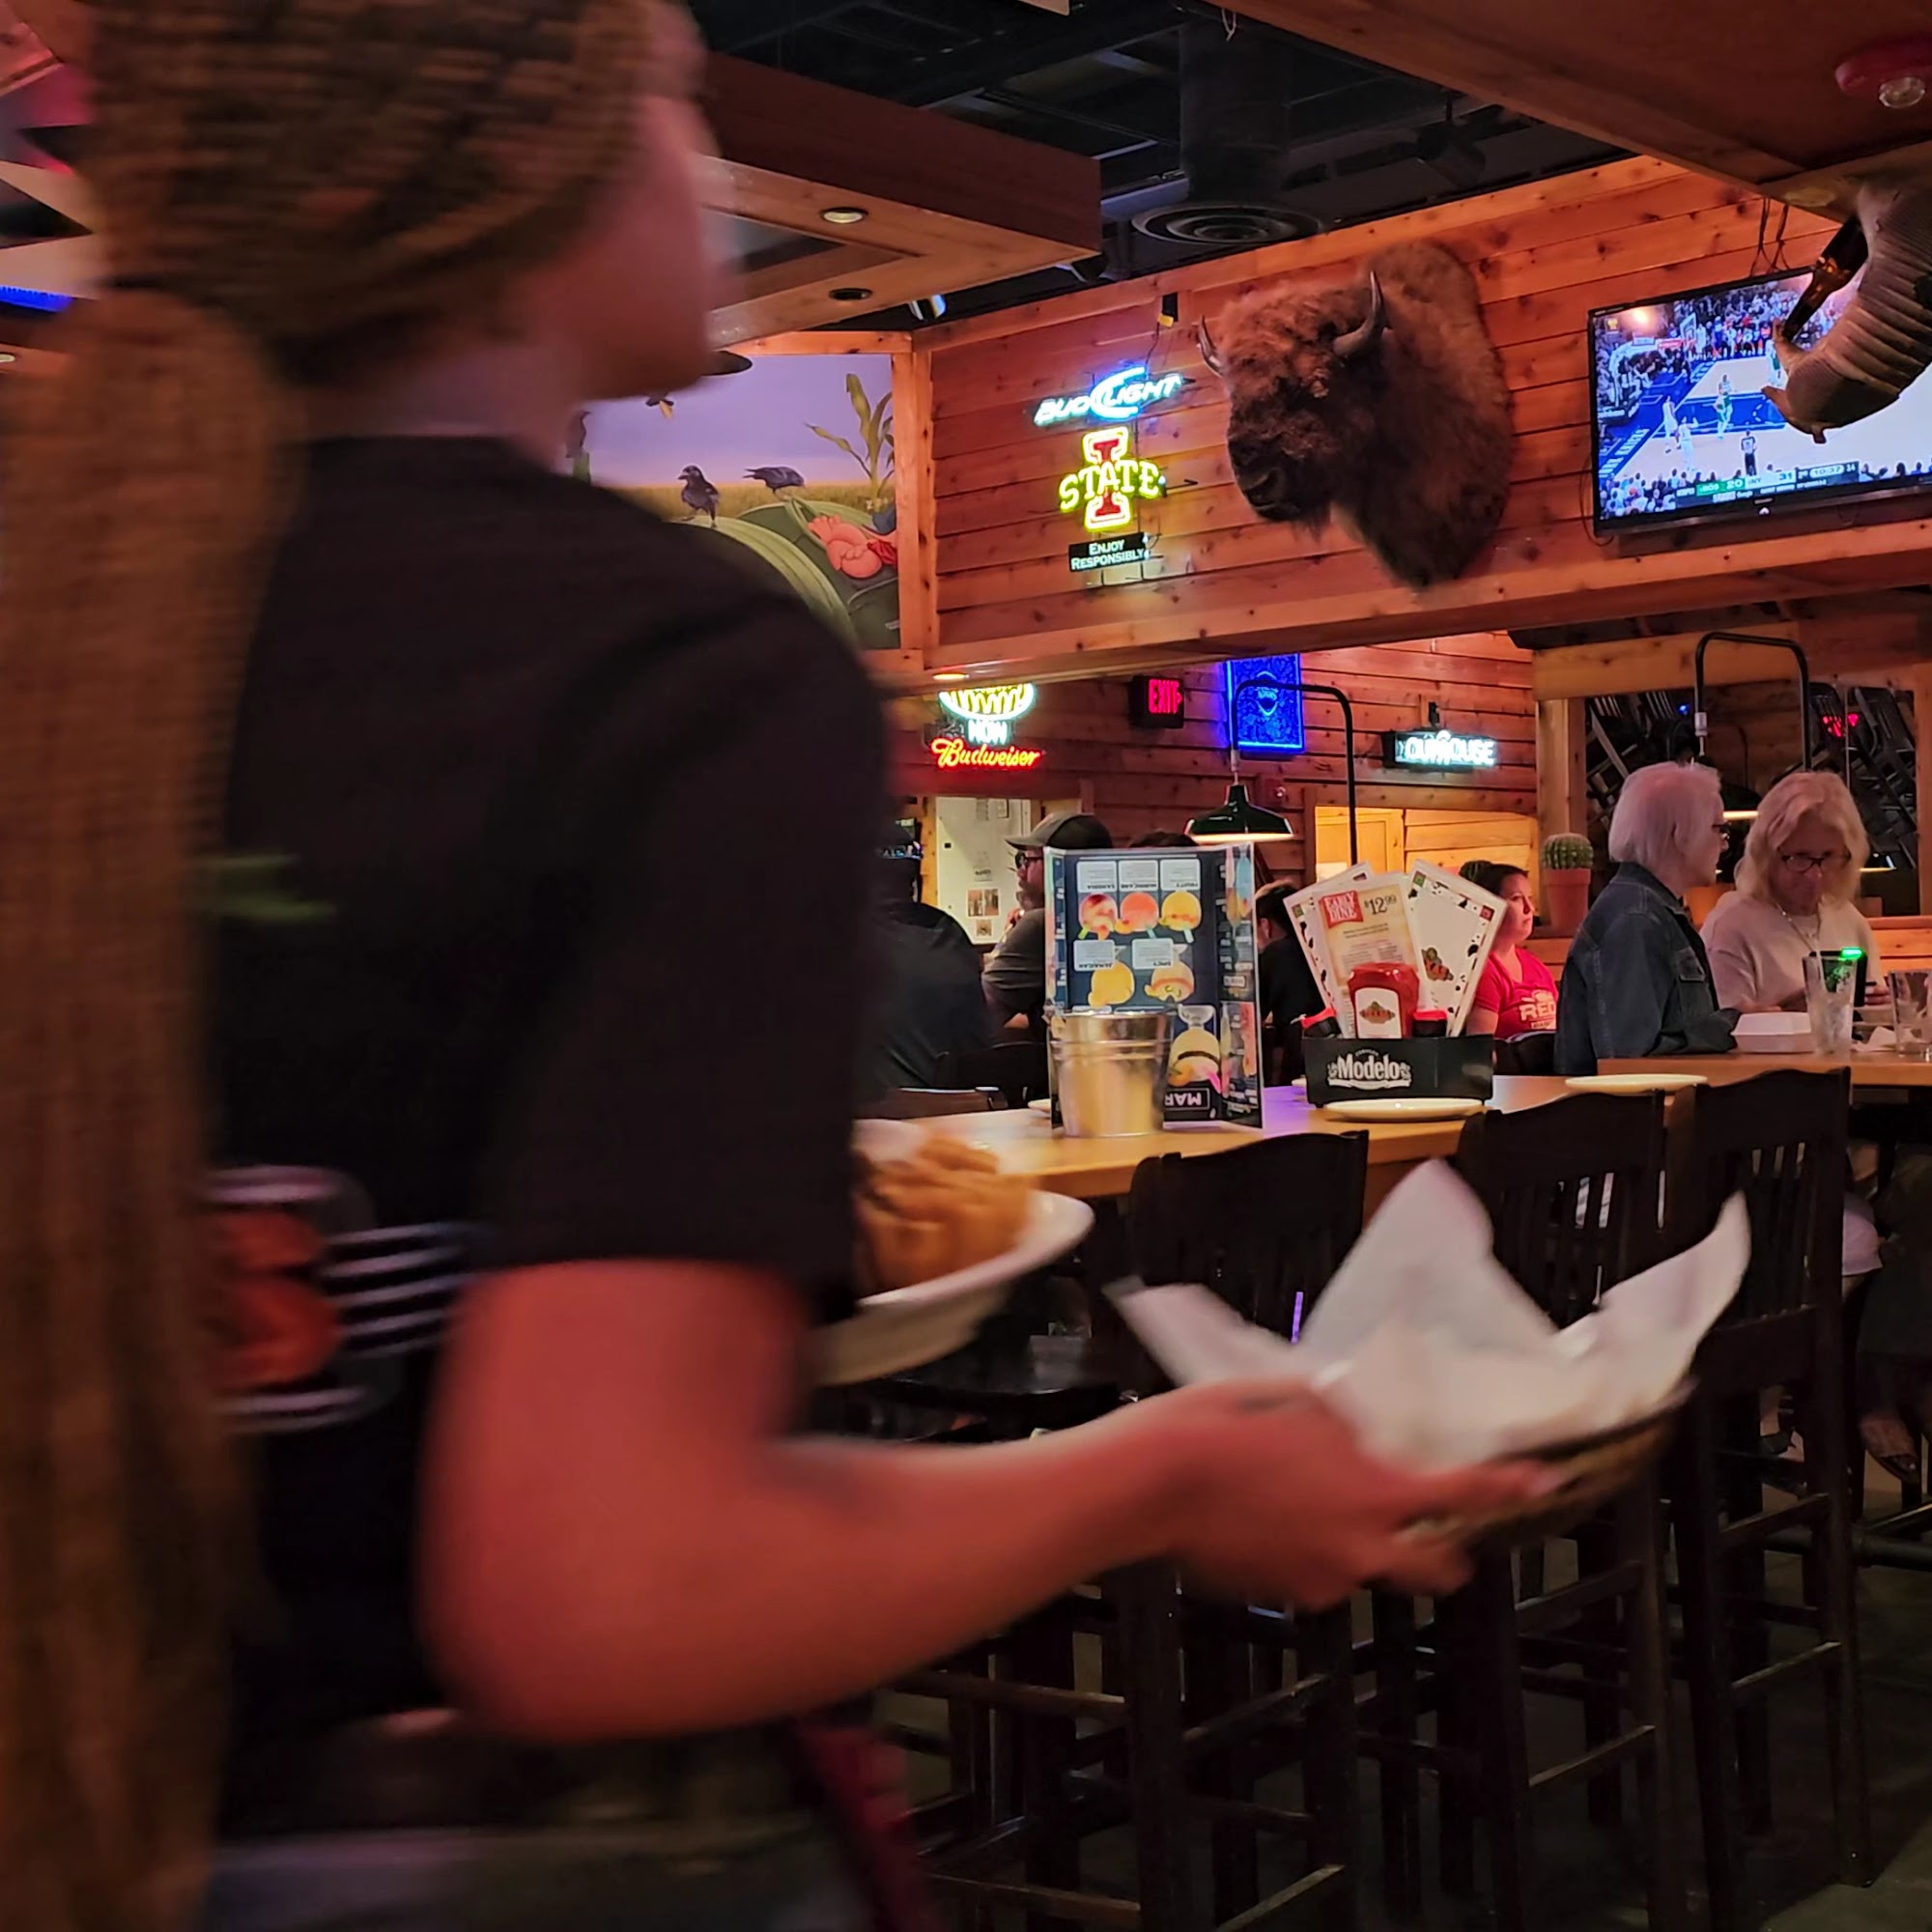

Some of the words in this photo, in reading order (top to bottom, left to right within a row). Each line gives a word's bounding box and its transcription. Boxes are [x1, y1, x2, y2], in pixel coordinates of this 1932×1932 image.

[1034, 395, 1091, 427] BUD
[1106, 373, 1183, 406] LIGHT
[1059, 459, 1159, 512] STATE
[1070, 549, 1144, 570] RESPONSIBLY
[1089, 539, 1124, 555] ENJOY
[1149, 678, 1179, 714] EXIT
[931, 738, 1040, 768] Budweiser
[1337, 1053, 1400, 1080] Modelo
